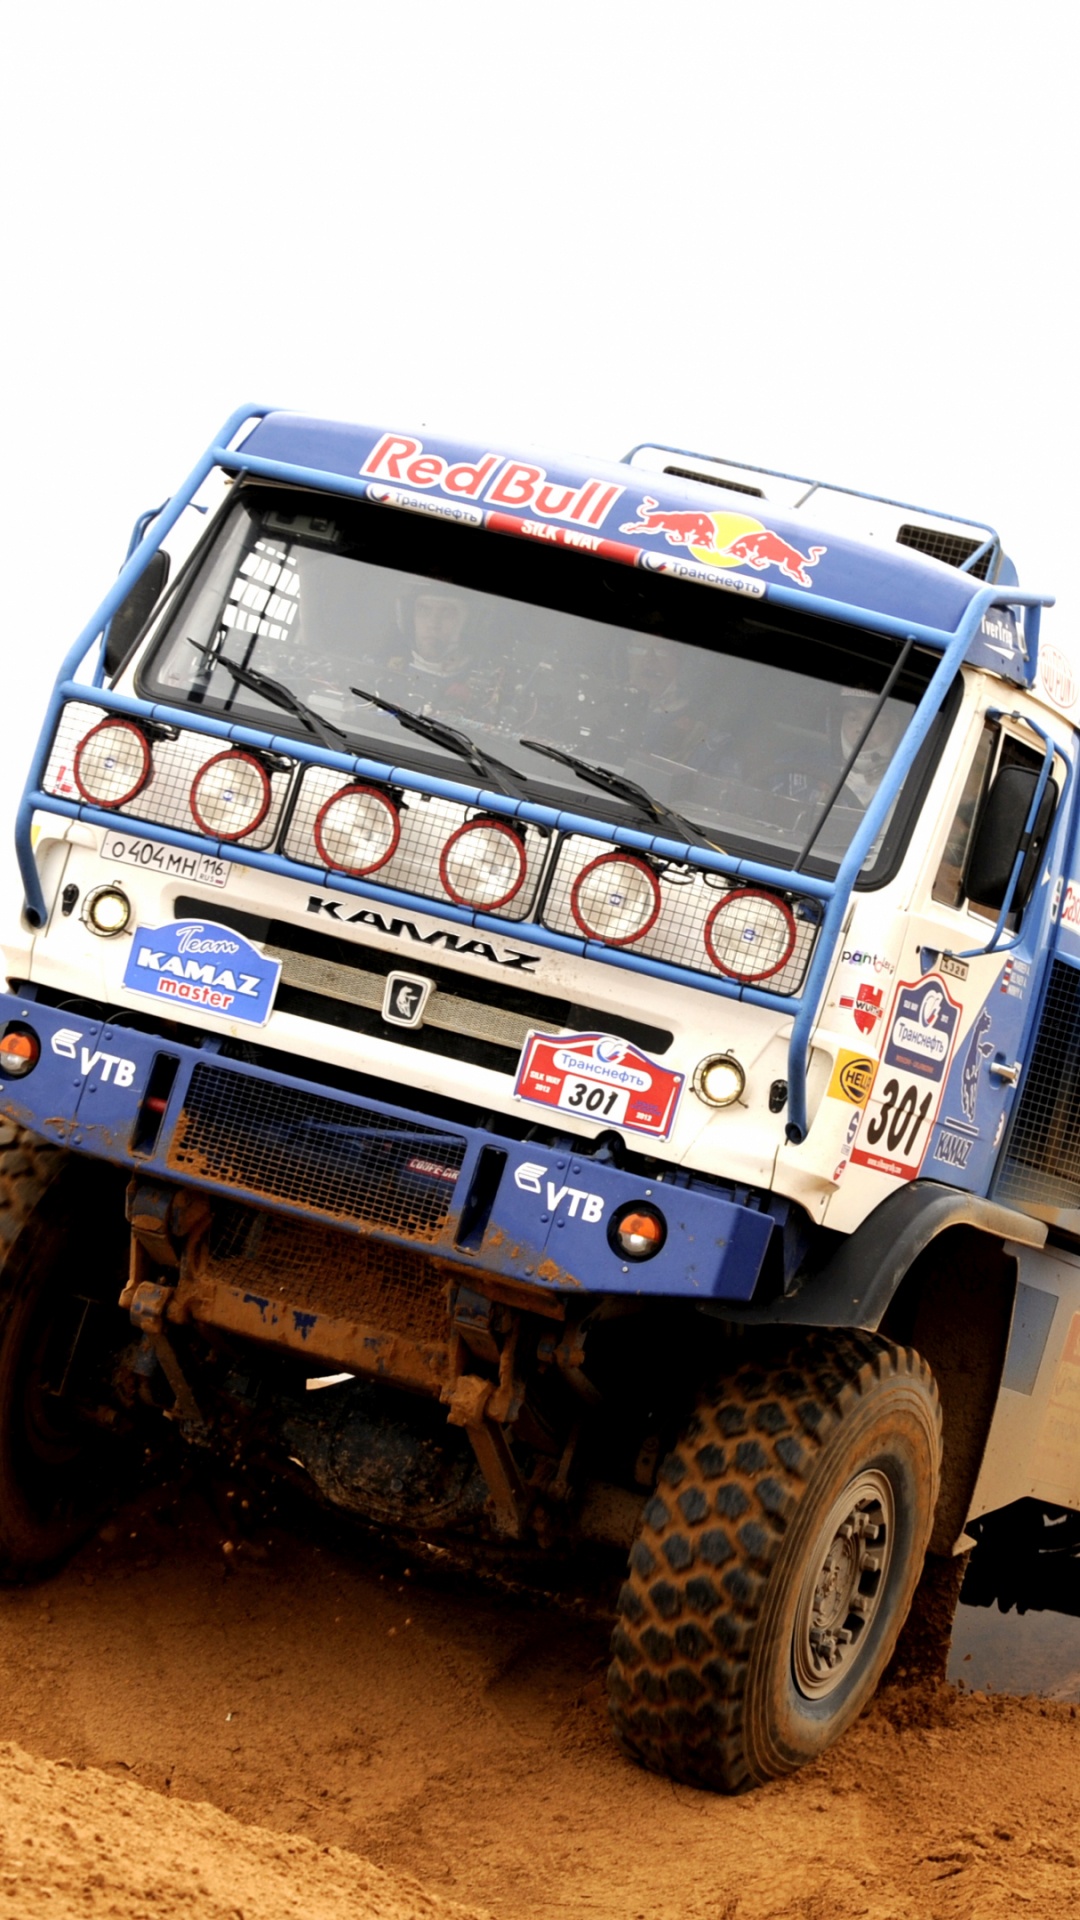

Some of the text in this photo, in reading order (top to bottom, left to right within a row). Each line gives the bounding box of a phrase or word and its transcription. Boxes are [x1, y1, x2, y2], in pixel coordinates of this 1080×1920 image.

[368, 437, 620, 524] Red Bull
[395, 492, 478, 522] Транснефть
[521, 520, 602, 551] SILK WAY
[672, 561, 761, 594] Транснефть
[199, 873, 215, 883] RUS
[203, 857, 223, 875] 116
[176, 926, 239, 953] Team
[307, 896, 541, 973] KAMAZ
[137, 948, 262, 996] KAMAZ
[159, 976, 233, 1009] master
[898, 1022, 944, 1053] Транснефть
[80, 1047, 136, 1087] VTB
[561, 1053, 644, 1087] Транснефть
[568, 1083, 619, 1115] 301
[867, 1078, 933, 1156] 301
[933, 1130, 974, 1170] KAMAZ
[546, 1182, 605, 1223] VTB
